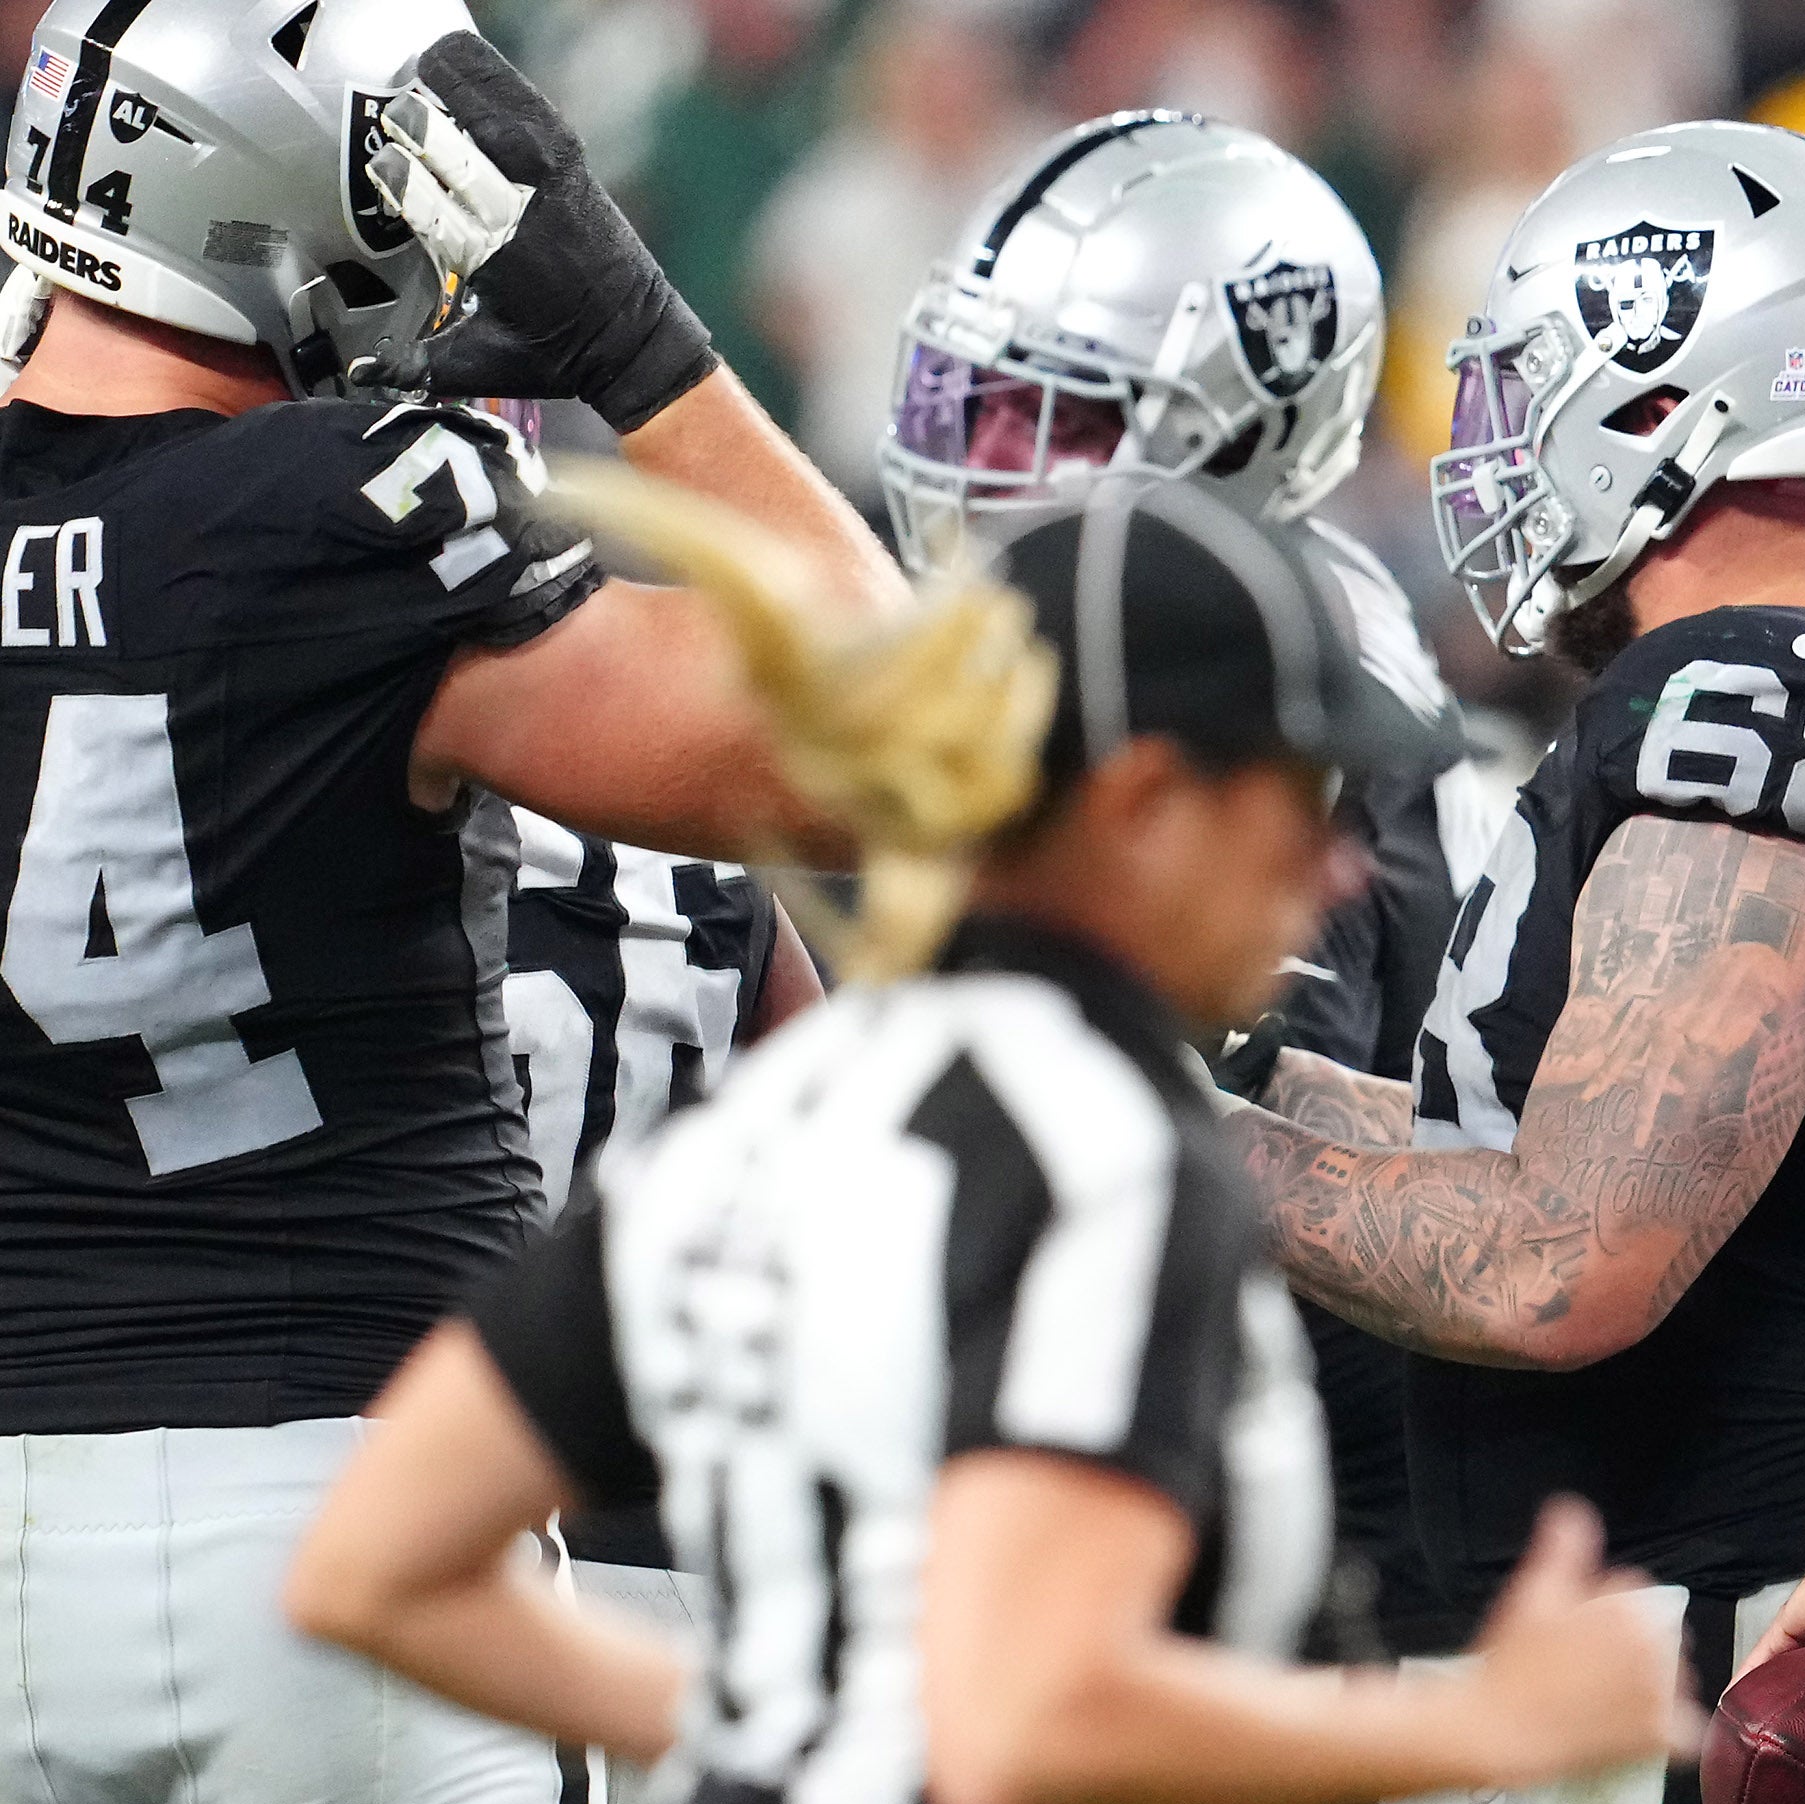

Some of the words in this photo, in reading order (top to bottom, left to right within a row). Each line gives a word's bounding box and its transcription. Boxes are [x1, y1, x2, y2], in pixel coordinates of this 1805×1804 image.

[113, 100, 147, 131] AL
[26, 124, 133, 236] 74
[8, 212, 122, 293] RAIDERS
[1586, 232, 1700, 260] RAIDERS
